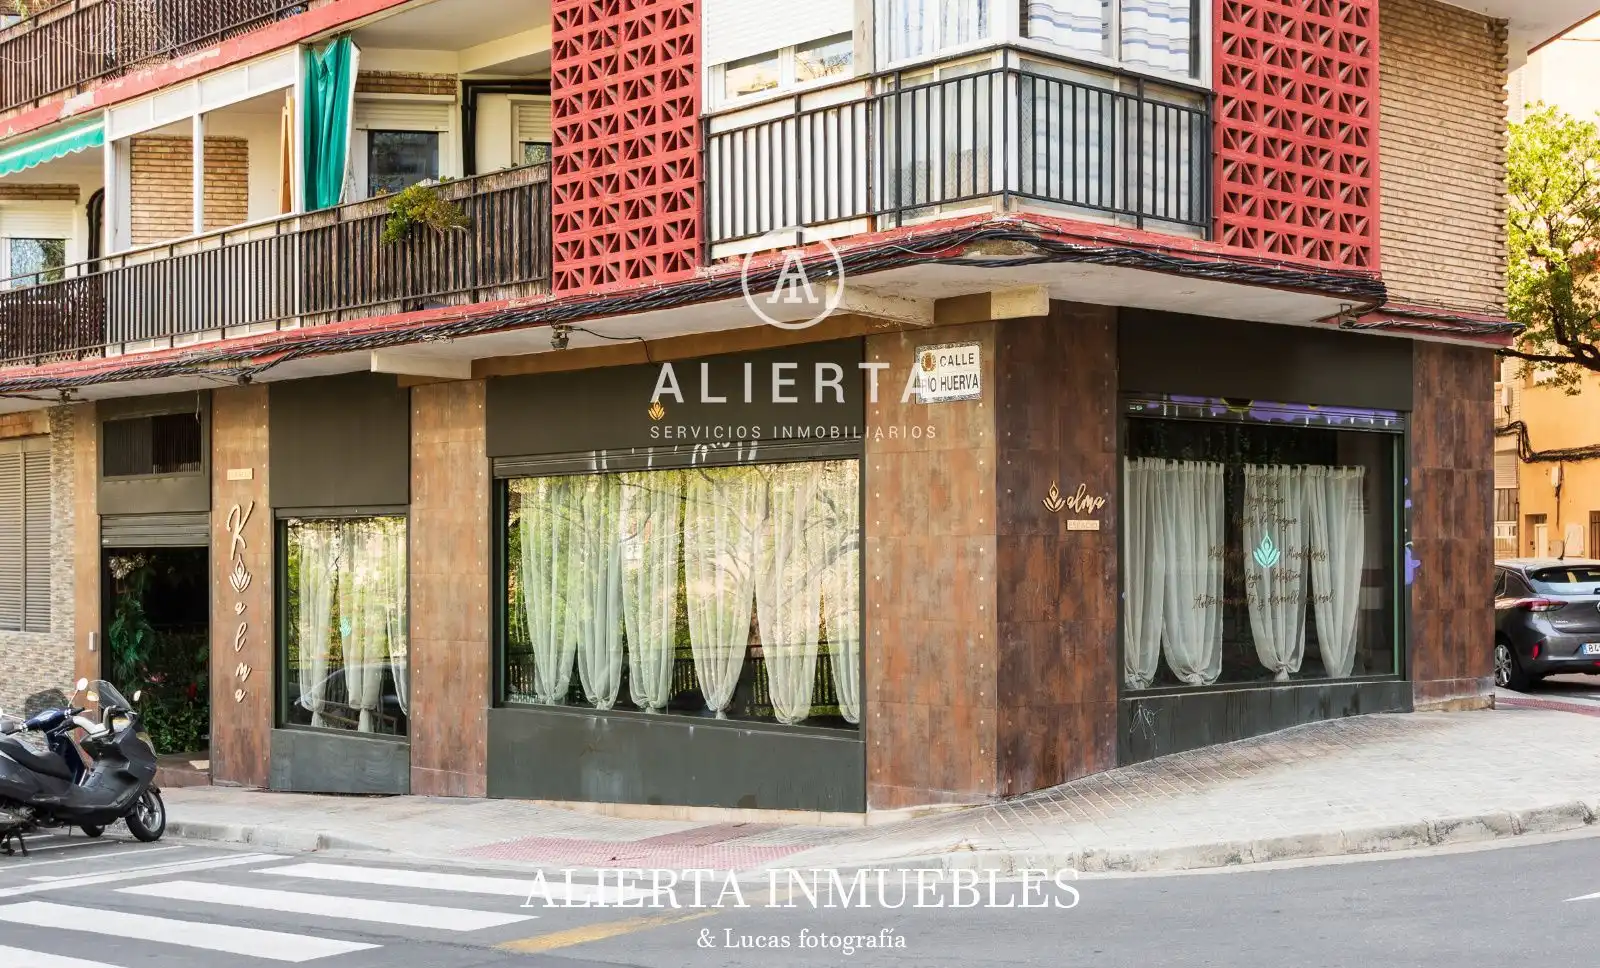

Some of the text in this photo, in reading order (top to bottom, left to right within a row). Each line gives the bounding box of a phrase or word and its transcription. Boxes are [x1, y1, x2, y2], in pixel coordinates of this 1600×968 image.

[940, 353, 974, 367] CALLE
[940, 374, 979, 392] HUERVA
[1067, 483, 1105, 513] alma
